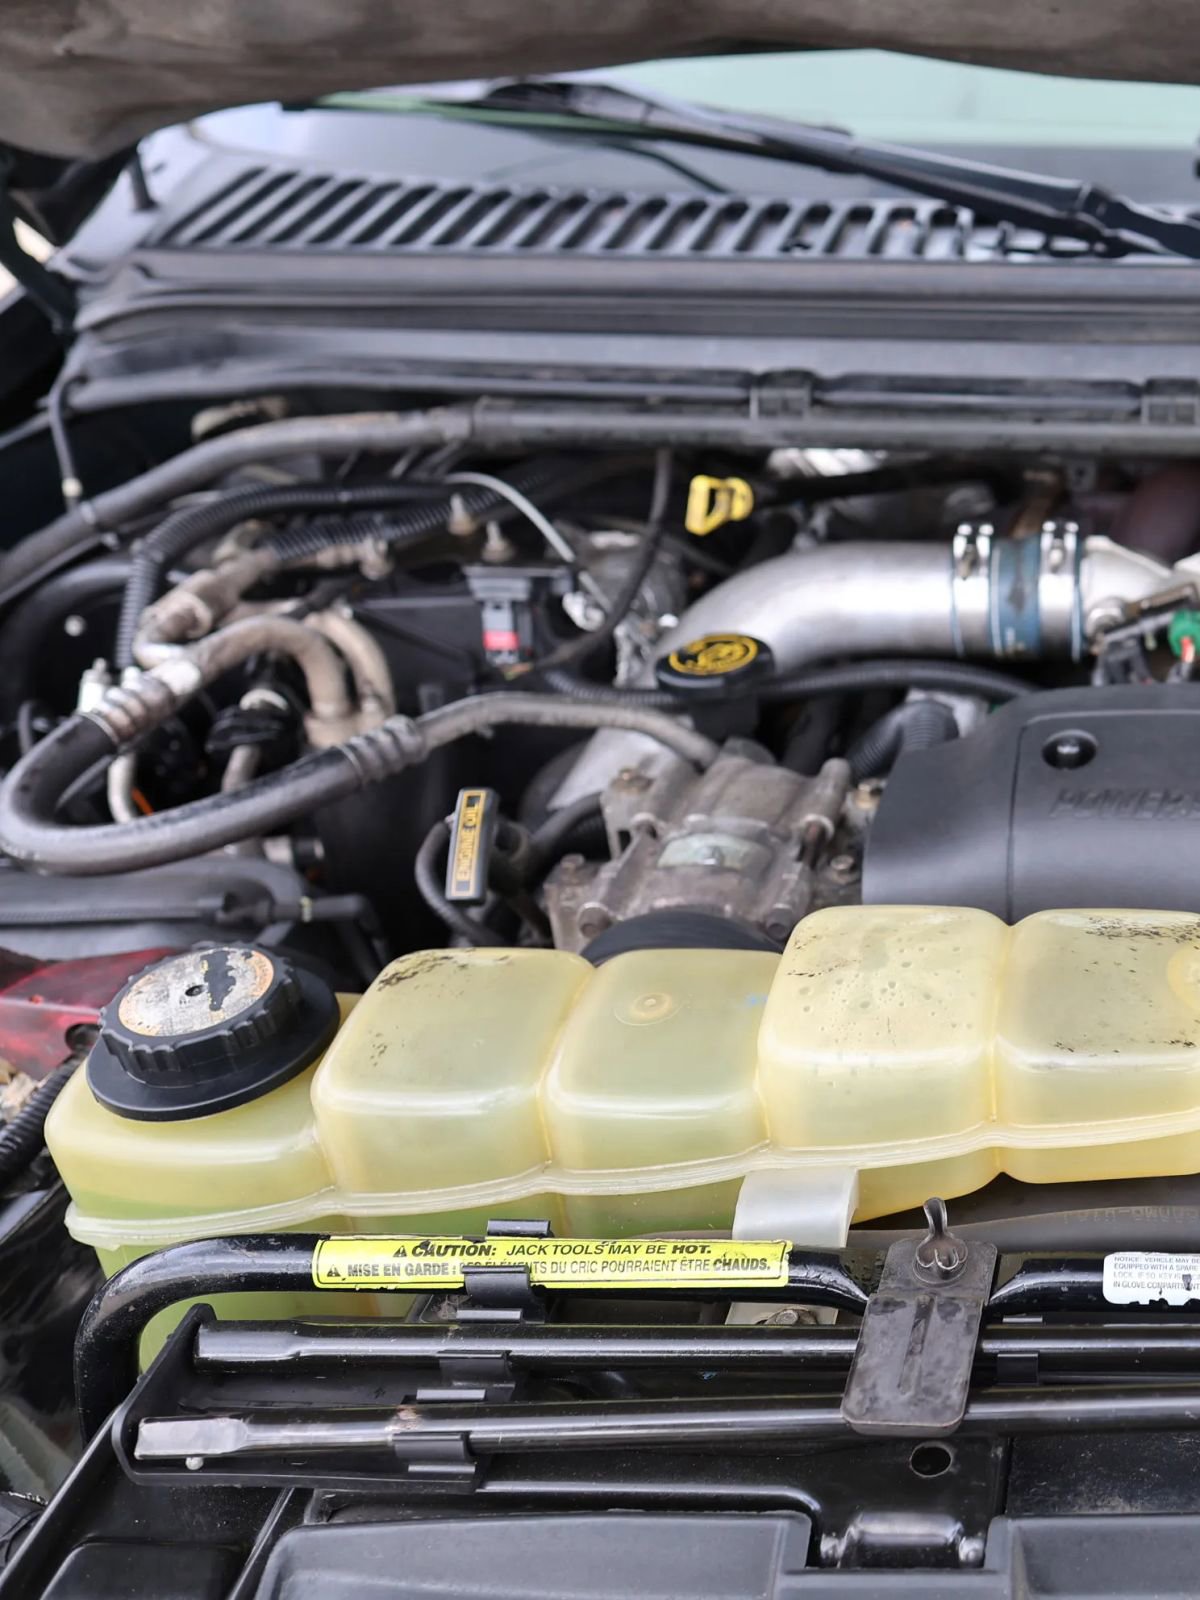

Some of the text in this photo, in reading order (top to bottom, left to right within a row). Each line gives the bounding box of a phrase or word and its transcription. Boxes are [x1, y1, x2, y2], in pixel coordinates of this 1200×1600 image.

[411, 1243, 712, 1257] CAUTION: JACK TOOLS MAY BE HOT.
[347, 1263, 380, 1277] MISE
[383, 1263, 401, 1276] EN
[404, 1262, 449, 1276] GARDE
[550, 1261, 569, 1274] DU
[570, 1260, 598, 1274] CRIC
[601, 1259, 677, 1273] POURRAIENT
[680, 1256, 710, 1272] ÊTRE
[713, 1257, 771, 1271] CHAUDS.
[1121, 1281, 1145, 1289] GLOVE
